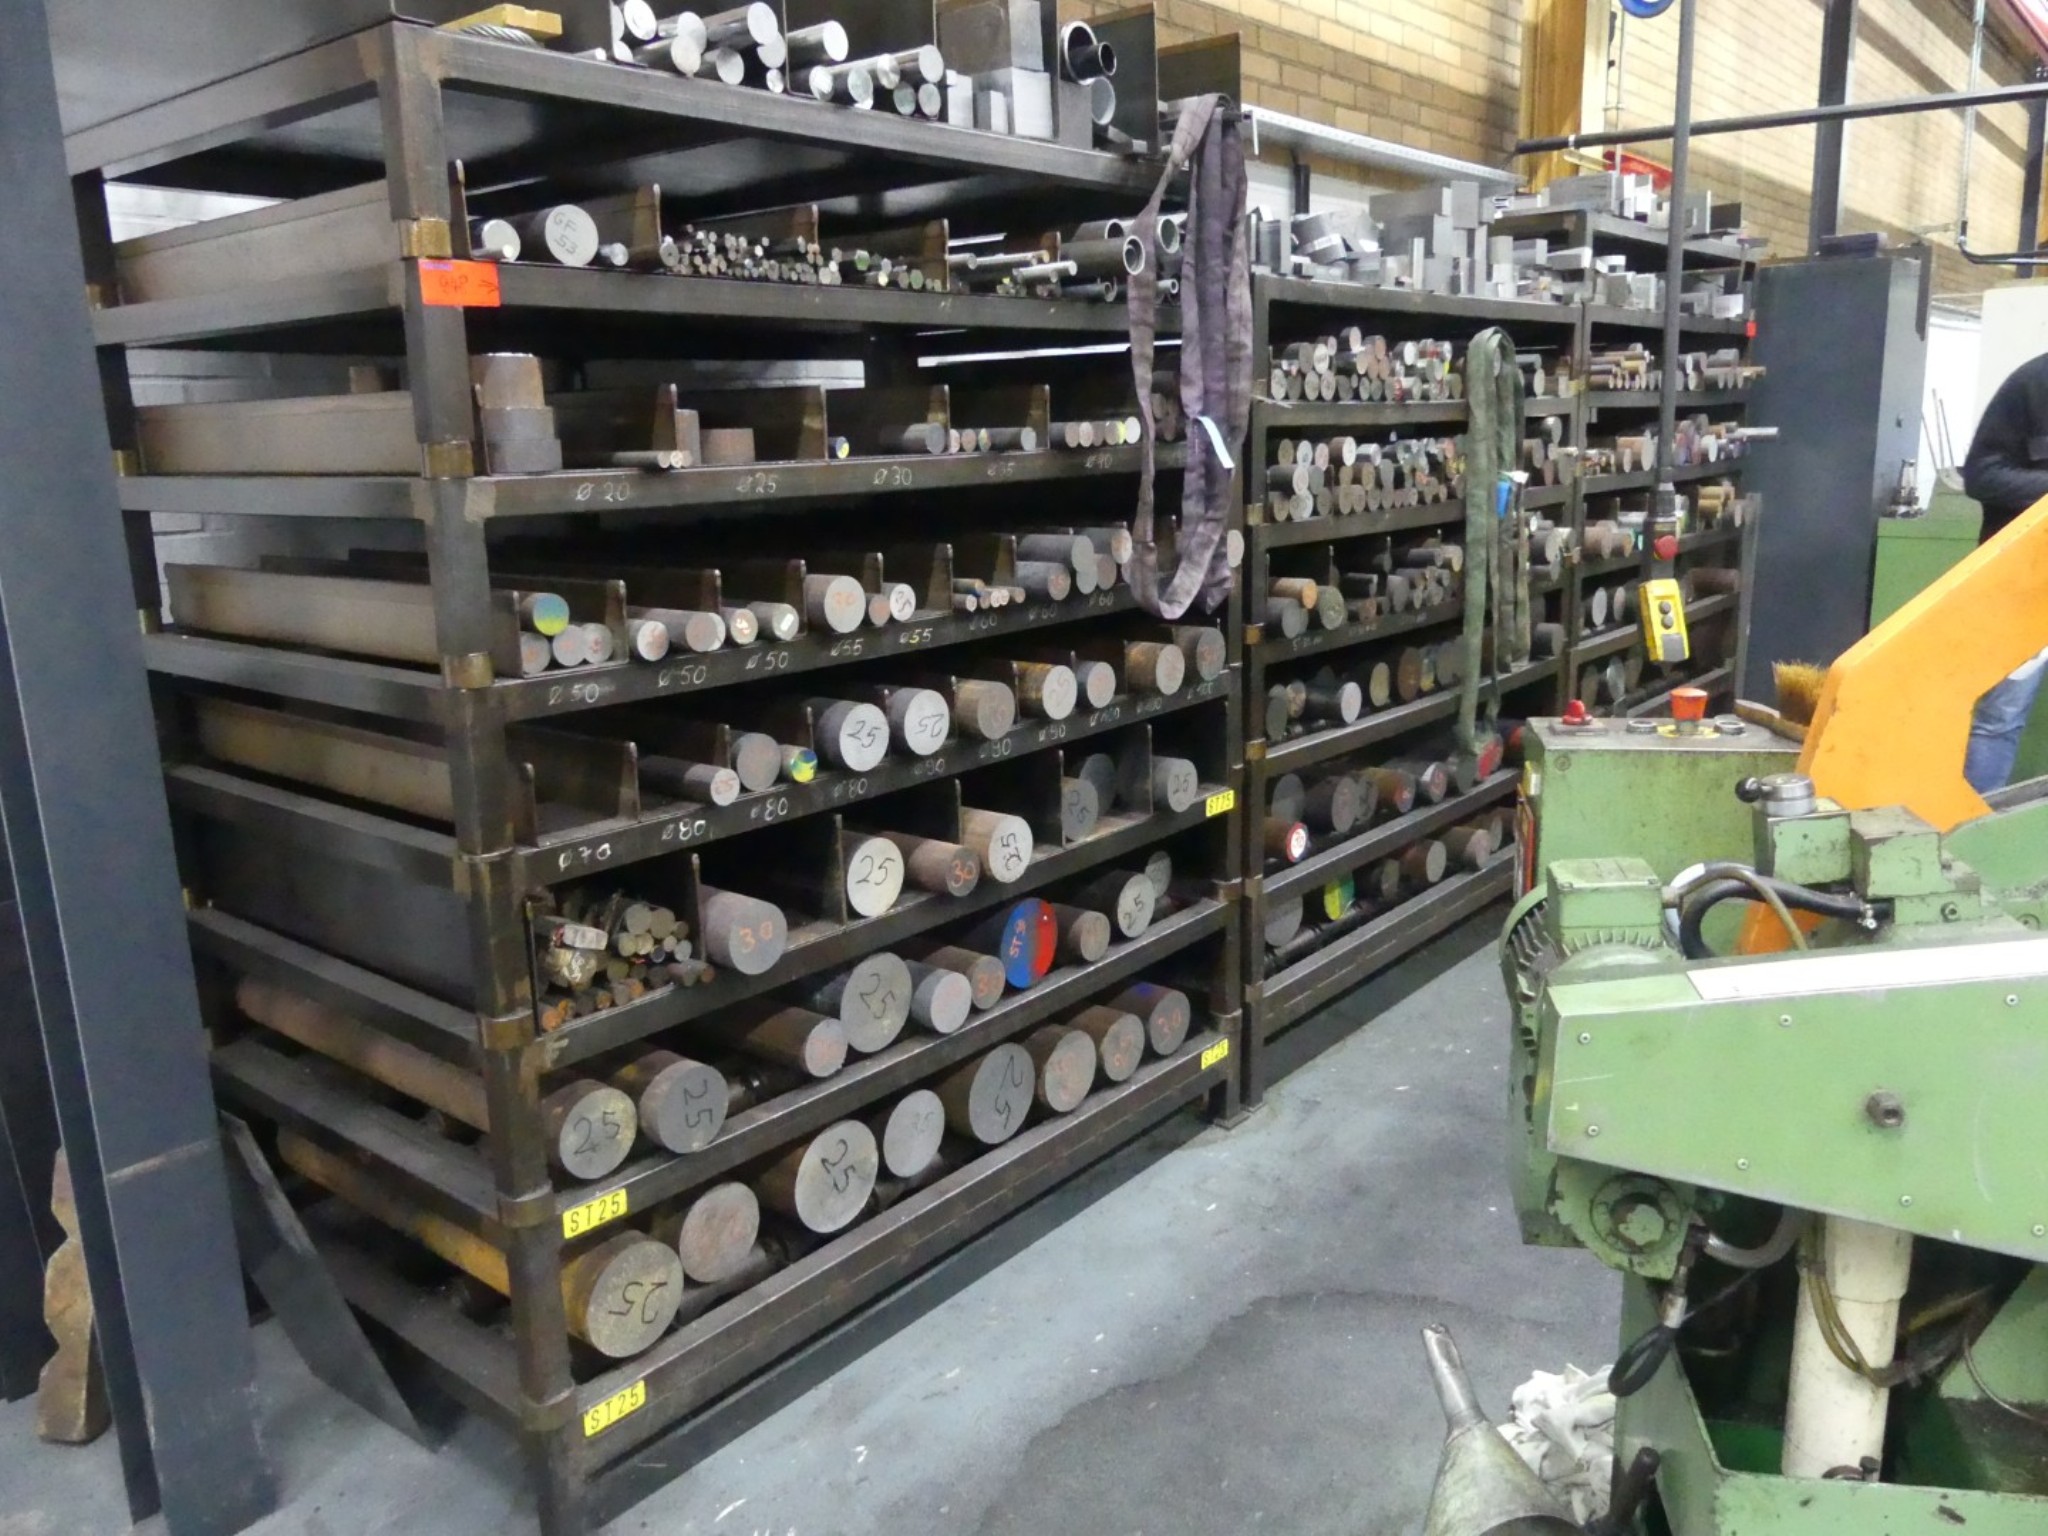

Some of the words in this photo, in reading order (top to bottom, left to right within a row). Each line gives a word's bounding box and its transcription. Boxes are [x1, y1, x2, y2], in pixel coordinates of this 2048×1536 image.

[846, 719, 882, 749] 25
[855, 854, 897, 887] 25
[858, 972, 897, 1020] 25
[572, 1111, 621, 1155] 25
[820, 1138, 857, 1194] 25
[569, 1192, 622, 1234] ST25
[607, 1280, 668, 1325] 25
[590, 1384, 641, 1431] ST25
